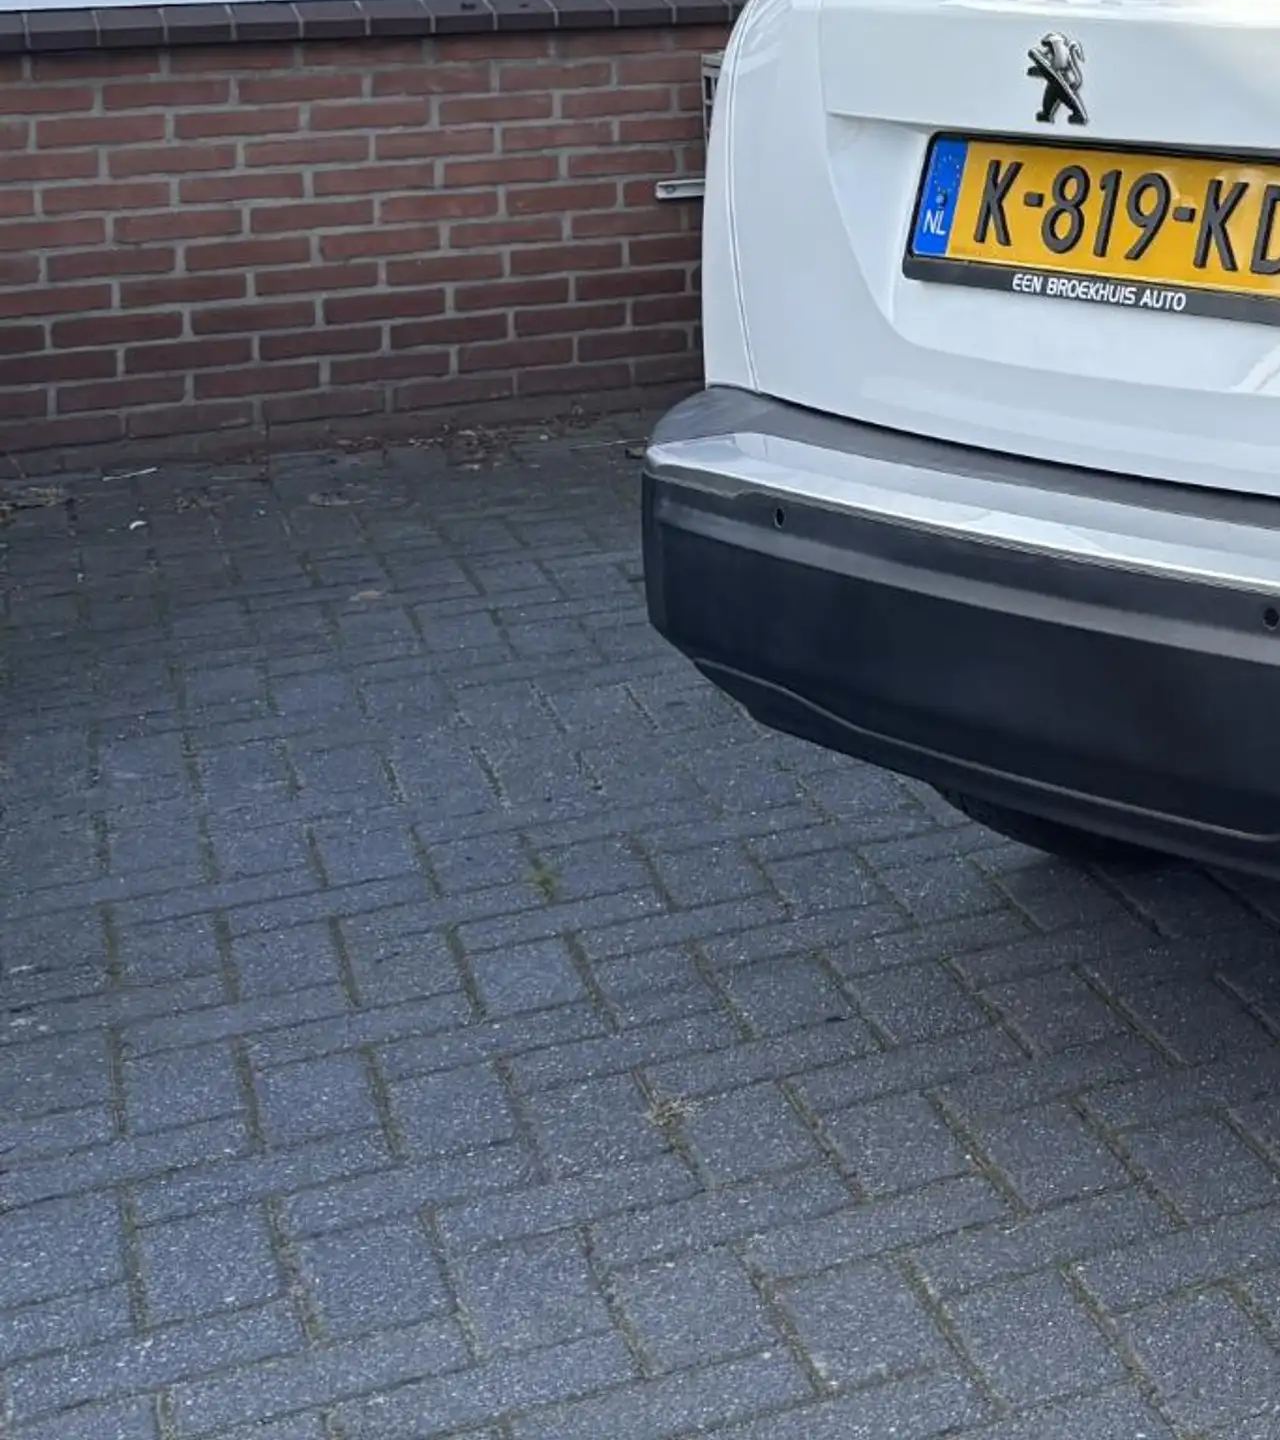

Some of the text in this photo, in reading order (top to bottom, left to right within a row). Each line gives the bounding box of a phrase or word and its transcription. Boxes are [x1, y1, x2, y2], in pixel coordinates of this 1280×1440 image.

[924, 211, 947, 236] NL
[1012, 273, 1187, 311] EEN BROEKHUIS AUTO
